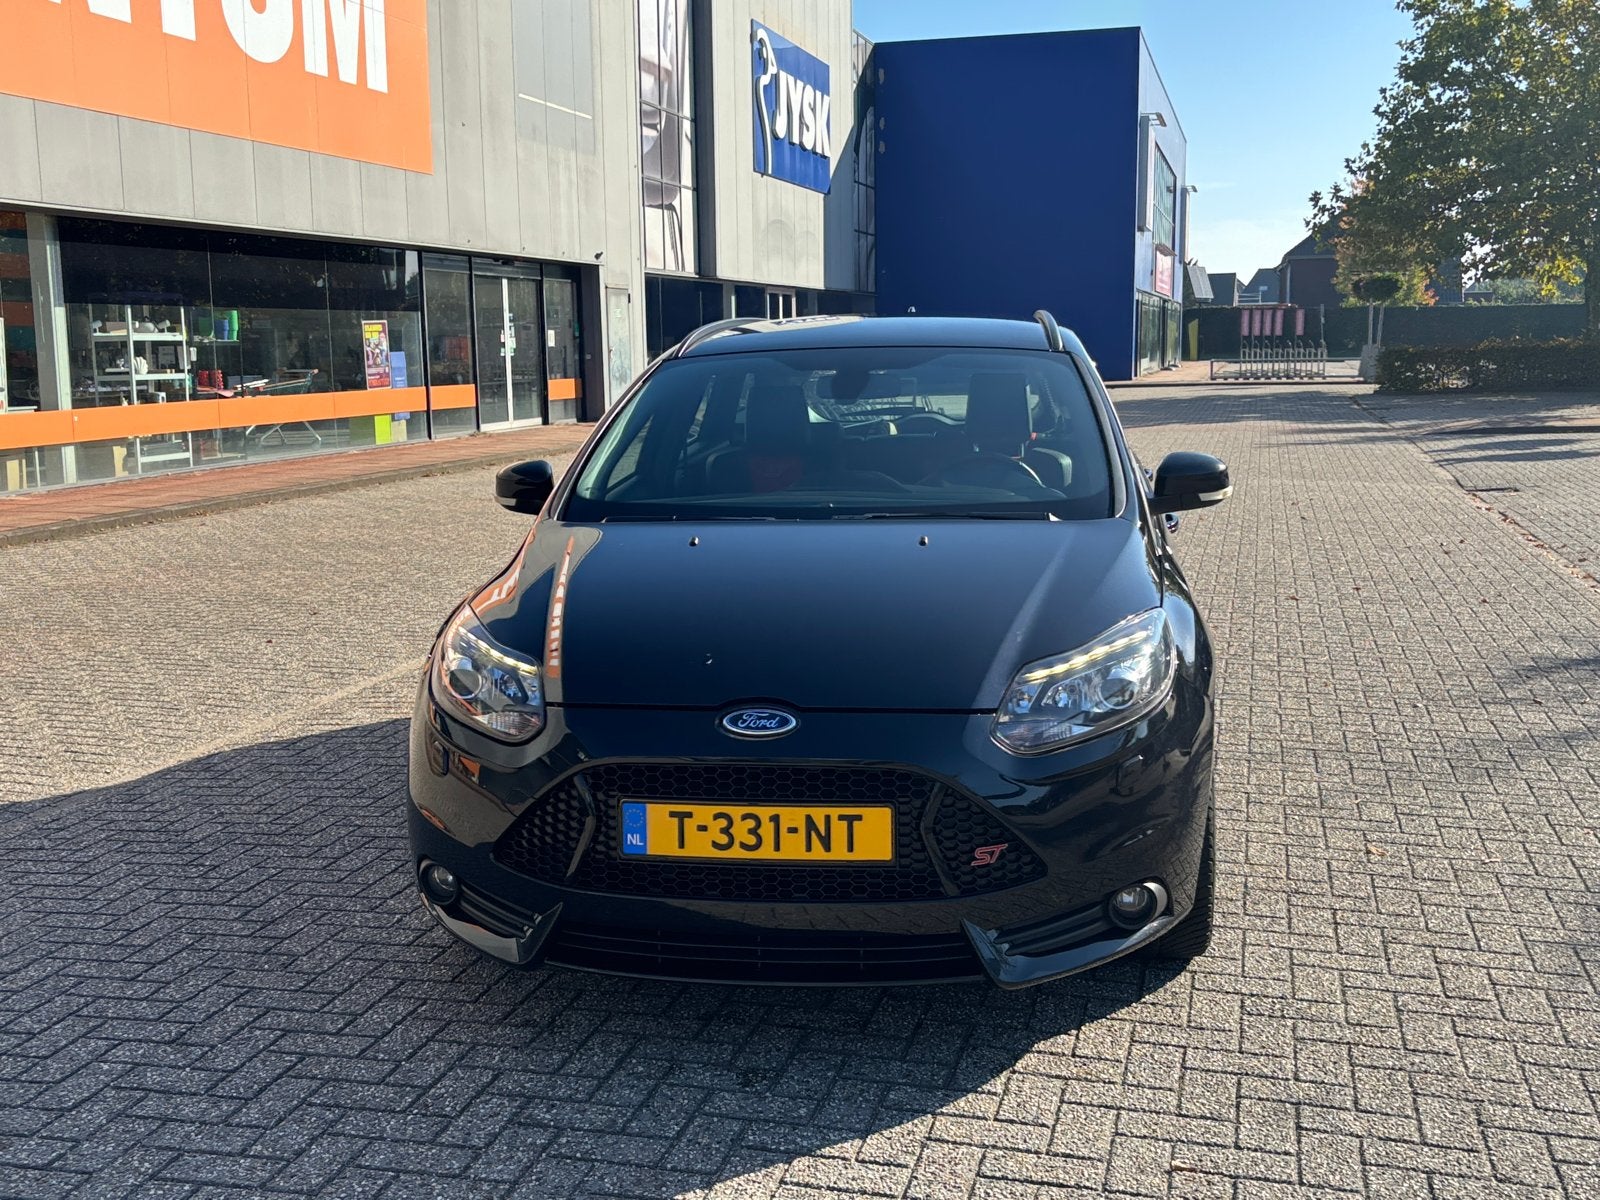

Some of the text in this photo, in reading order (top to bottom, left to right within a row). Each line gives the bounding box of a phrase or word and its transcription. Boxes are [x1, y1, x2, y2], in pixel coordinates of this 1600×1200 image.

[775, 69, 831, 158] JYSK
[738, 711, 779, 729] Ford
[626, 833, 644, 846] NL
[668, 810, 863, 853] T-331-NT
[971, 843, 1008, 866] ST
